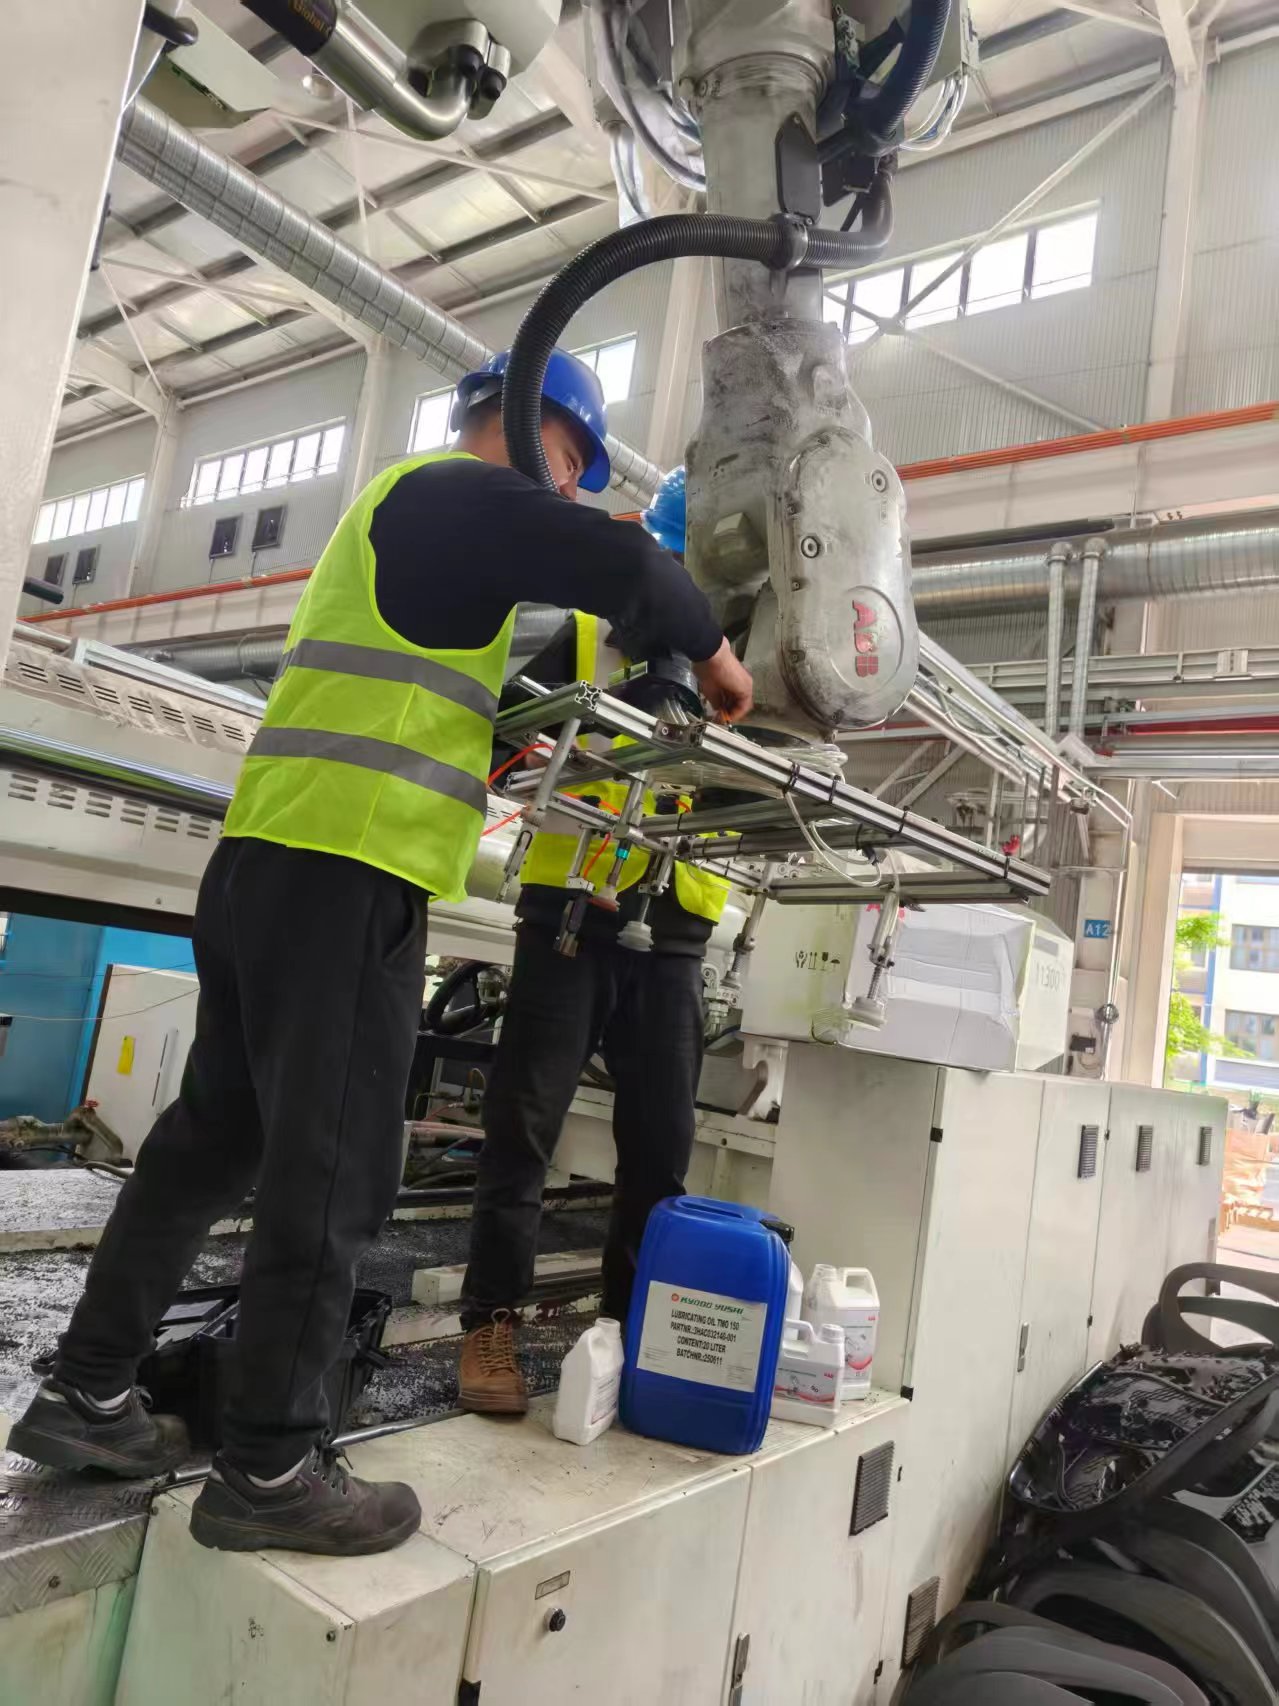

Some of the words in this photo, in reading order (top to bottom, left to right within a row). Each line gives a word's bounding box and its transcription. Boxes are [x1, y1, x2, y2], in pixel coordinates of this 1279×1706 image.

[852, 600, 879, 678] ABB
[1086, 923, 1112, 937] A12
[680, 1296, 713, 1308] KYODO
[714, 1304, 744, 1314] YUSHI
[671, 1309, 706, 1324] LUBRICATING
[707, 1316, 716, 1326] OIL
[711, 1343, 726, 1353] LITER
